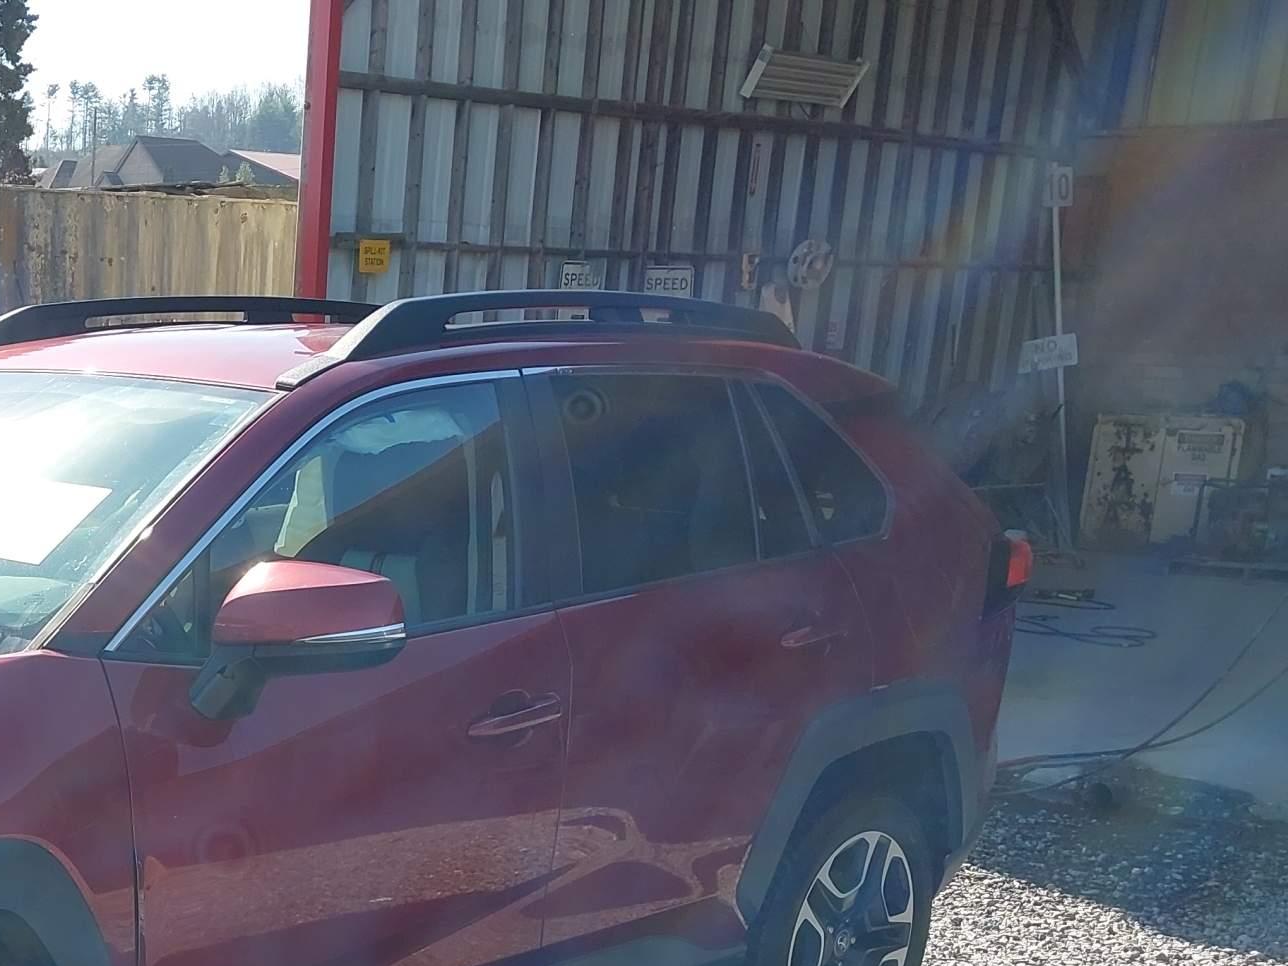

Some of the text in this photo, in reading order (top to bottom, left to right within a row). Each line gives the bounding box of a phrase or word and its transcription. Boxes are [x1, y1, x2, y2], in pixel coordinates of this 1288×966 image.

[1048, 173, 1070, 201] 10
[563, 272, 601, 287] SPEED
[645, 276, 689, 291] SPEED
[1033, 340, 1058, 353] NO
